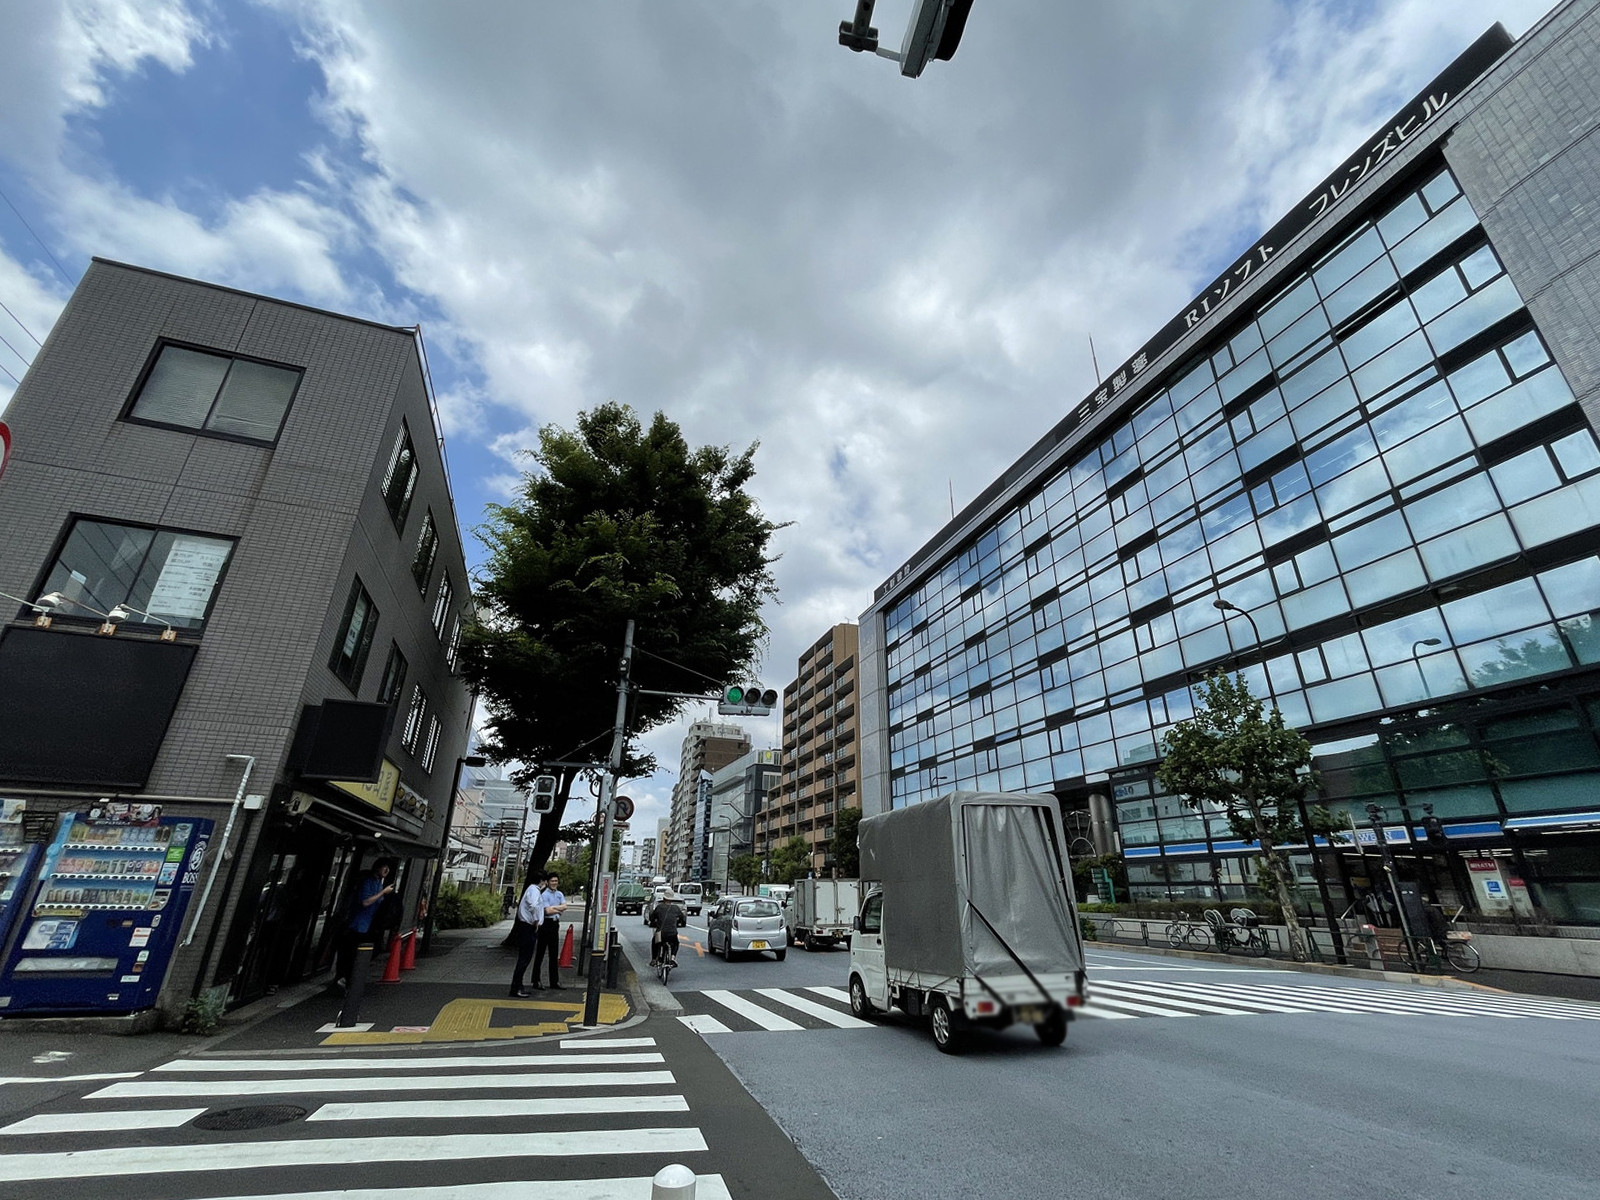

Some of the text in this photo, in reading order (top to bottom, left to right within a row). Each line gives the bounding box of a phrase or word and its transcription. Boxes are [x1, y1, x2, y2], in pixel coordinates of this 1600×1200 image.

[1308, 92, 1448, 217] フレンズヒル
[1184, 244, 1274, 329] RIソフト
[1077, 352, 1149, 424] 三宝製薬
[1345, 830, 1392, 844] LWSN
